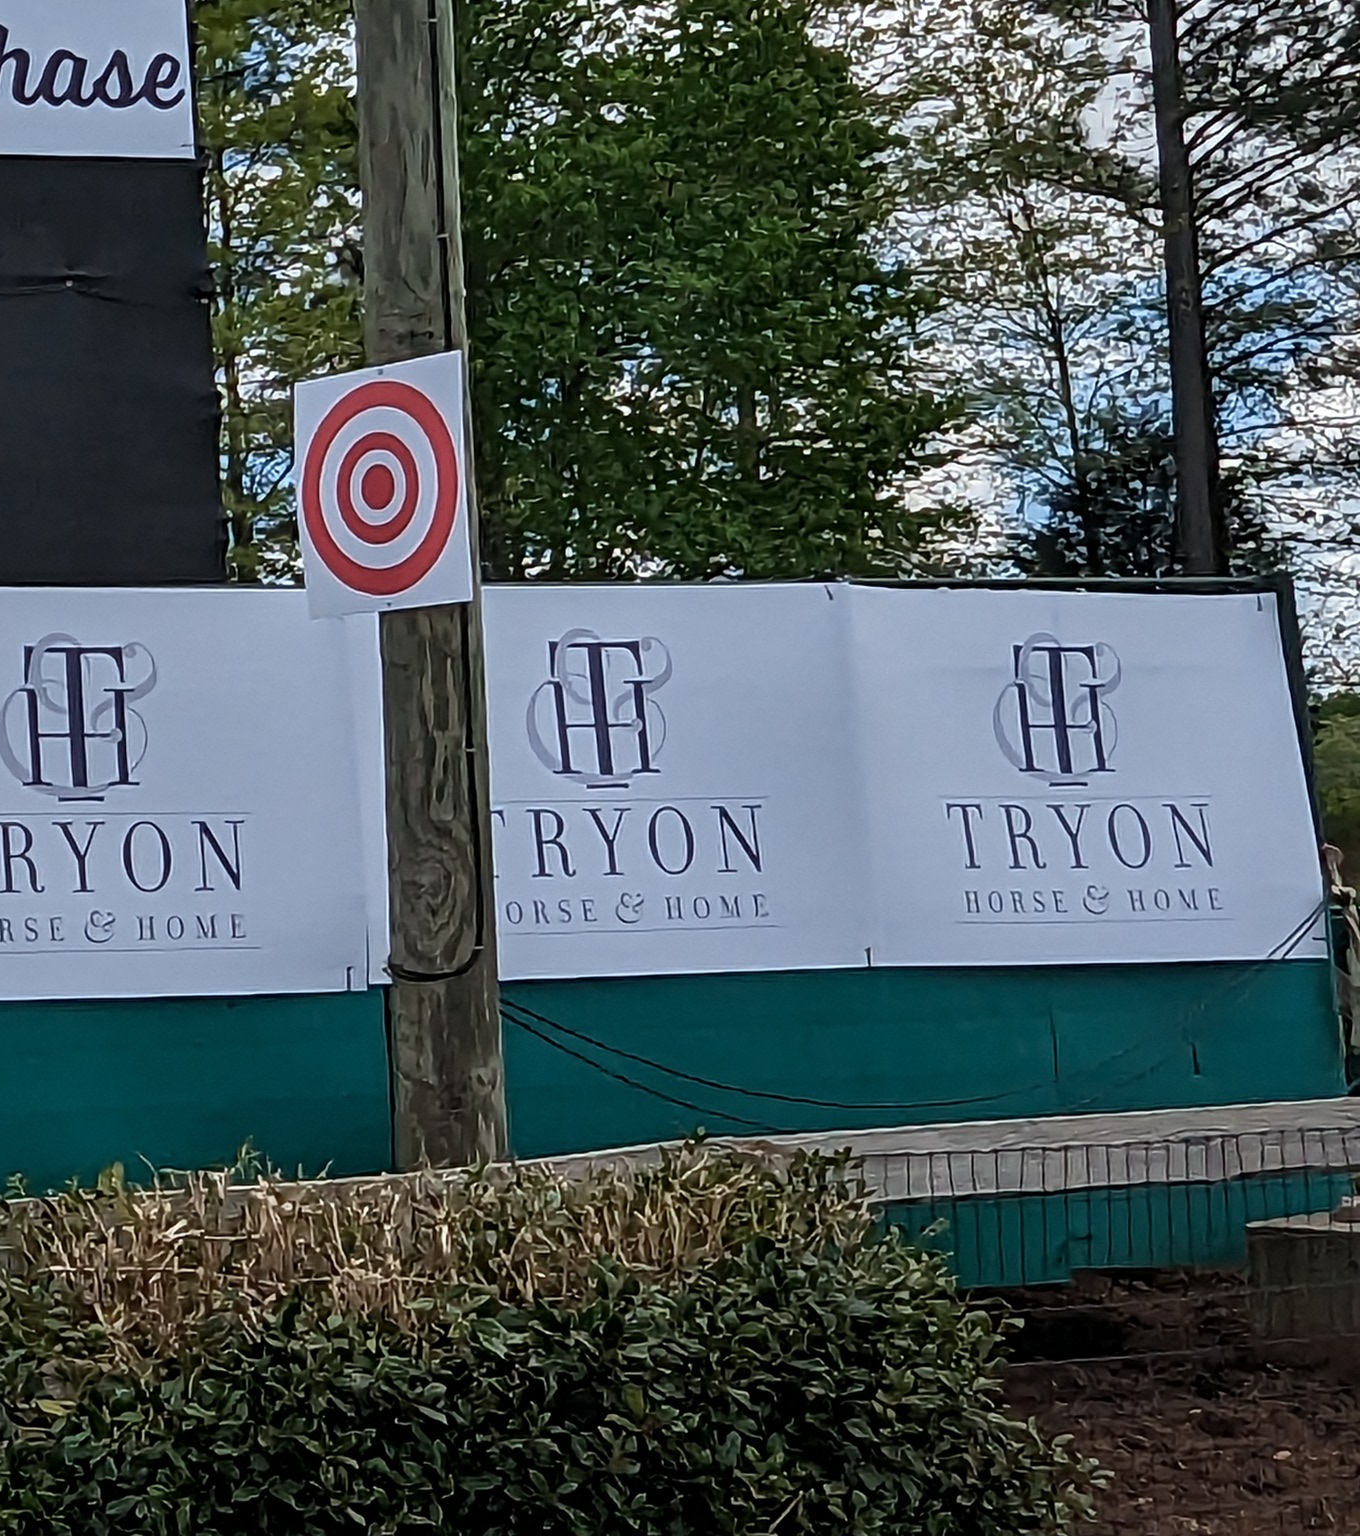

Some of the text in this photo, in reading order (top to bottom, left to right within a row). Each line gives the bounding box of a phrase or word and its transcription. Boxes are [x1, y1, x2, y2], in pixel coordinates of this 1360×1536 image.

[946, 803, 1213, 869] TRYON
[615, 893, 644, 924] &
[665, 894, 769, 920] HOME
[965, 885, 1223, 915] HORSE & HOME
[84, 910, 116, 943] &
[137, 914, 246, 940] HOME
